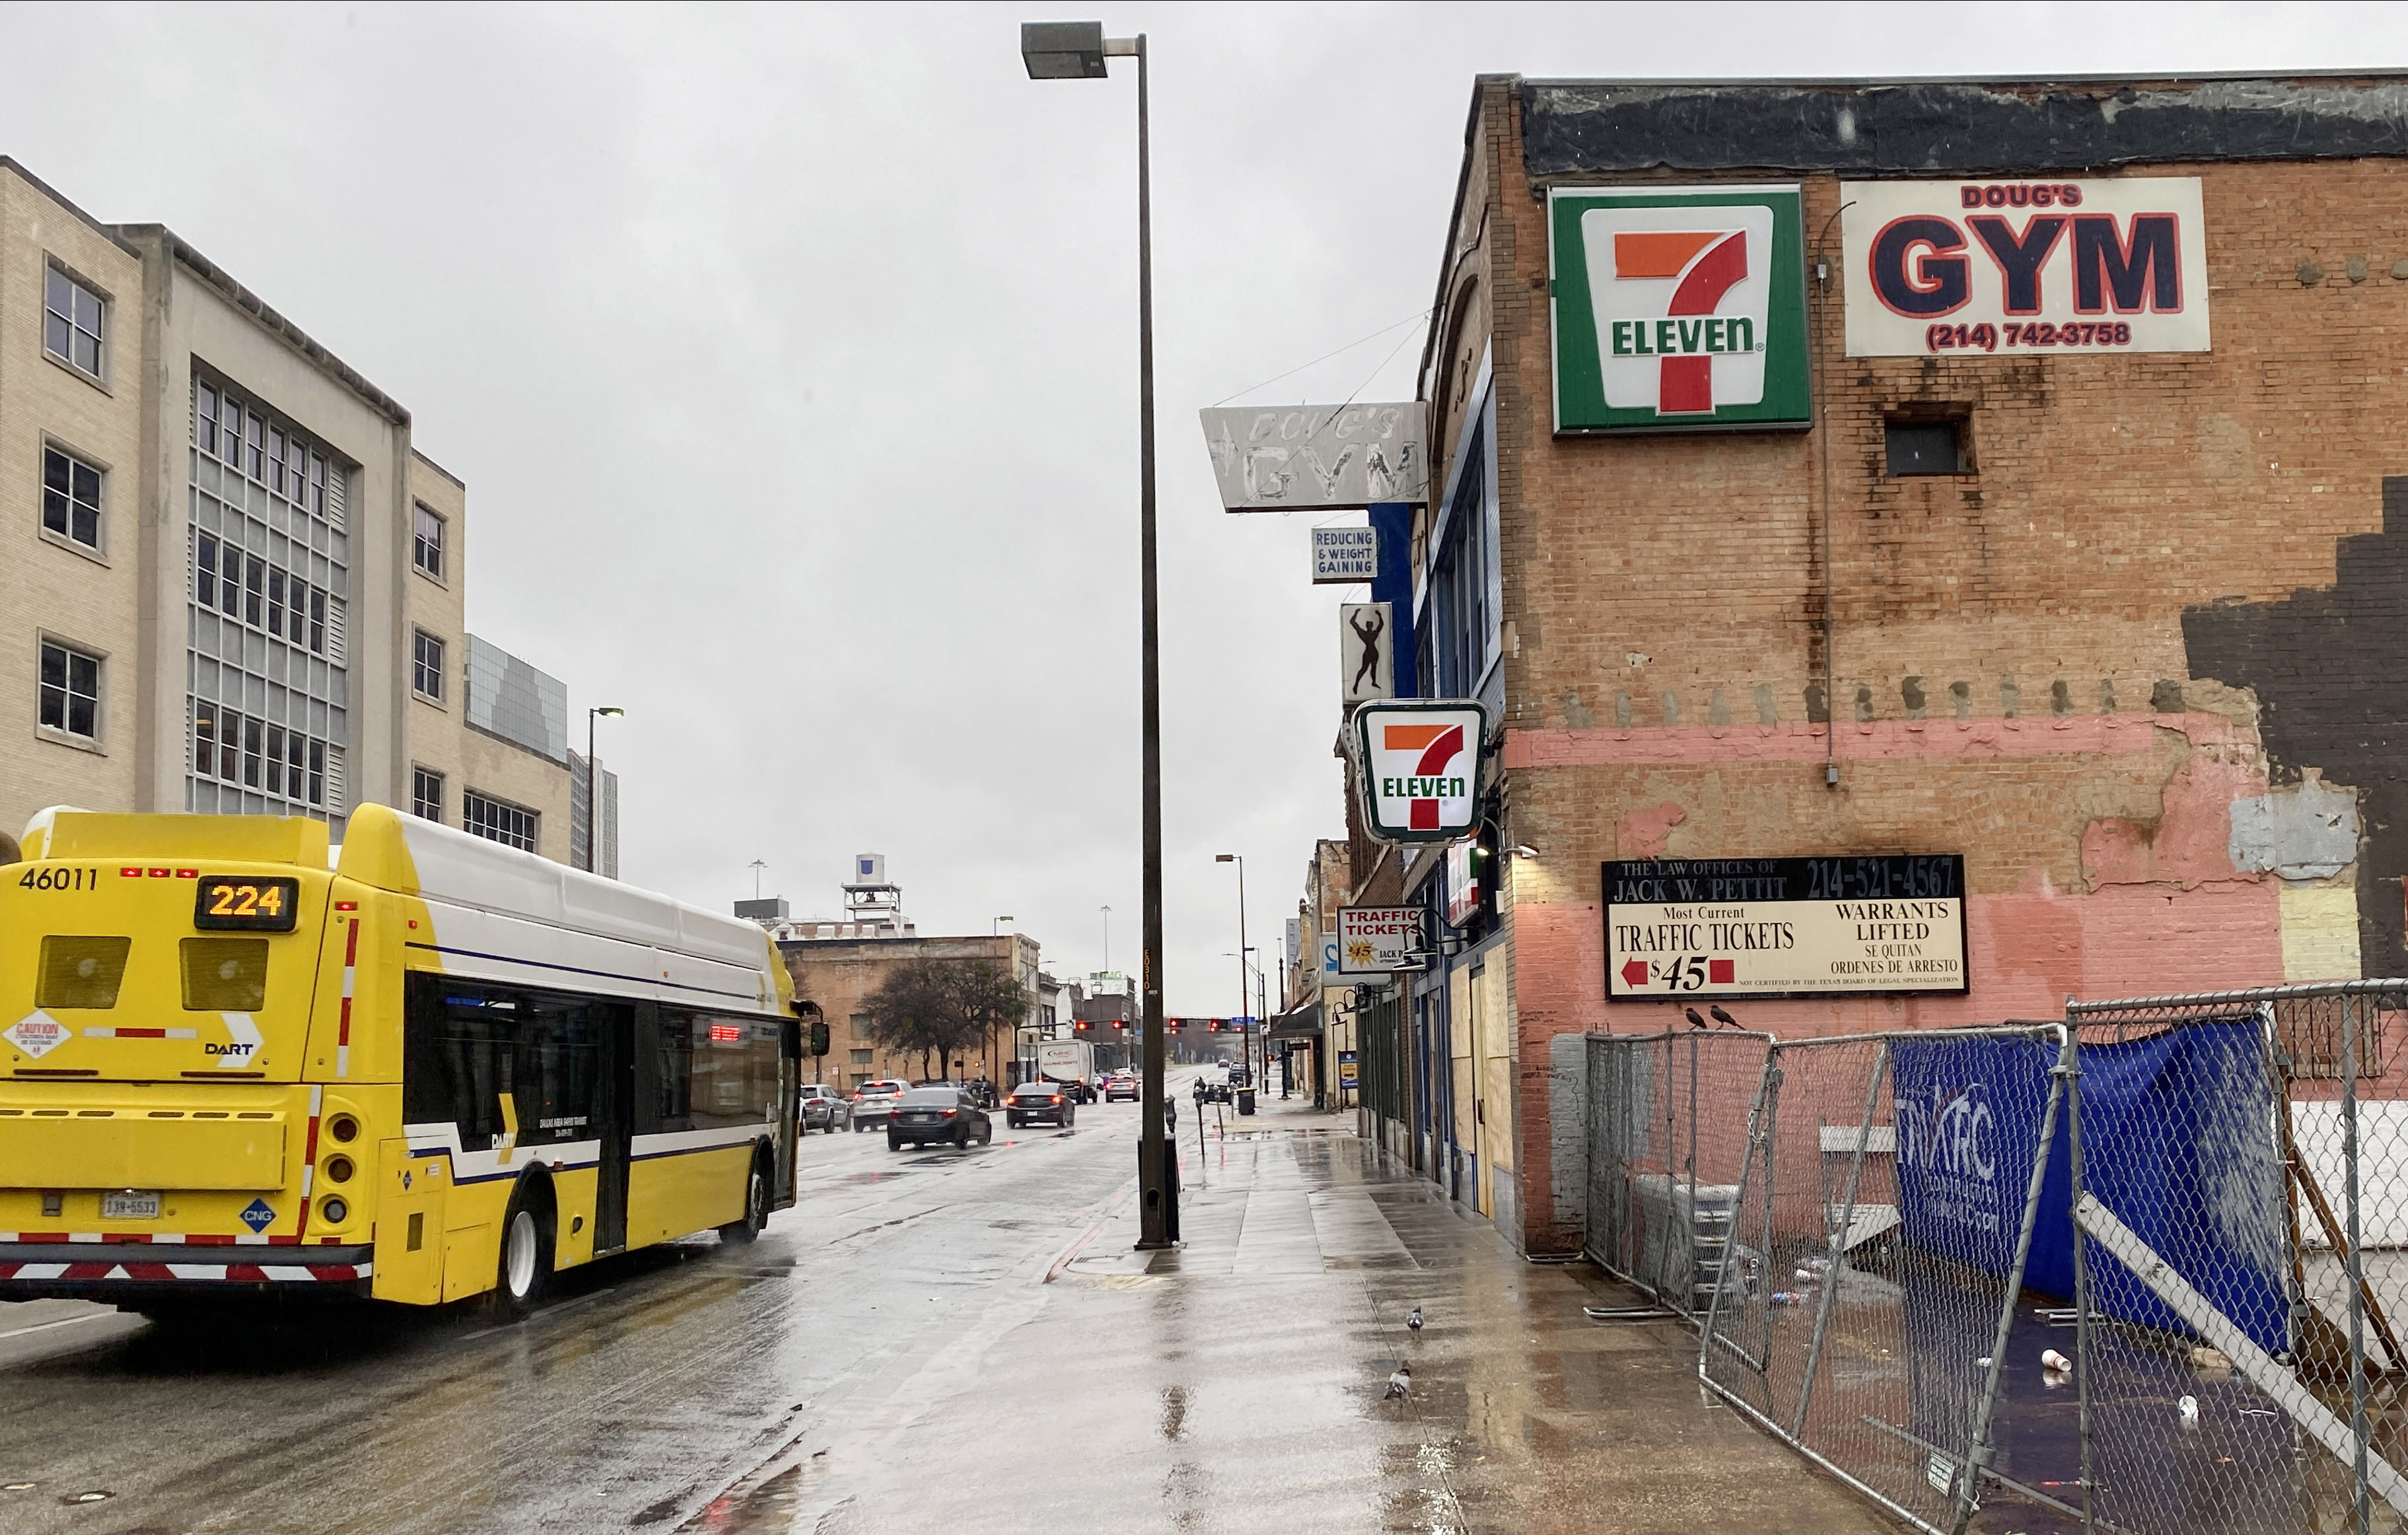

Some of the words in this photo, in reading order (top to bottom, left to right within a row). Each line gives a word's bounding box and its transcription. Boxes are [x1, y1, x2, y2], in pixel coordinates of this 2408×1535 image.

[1961, 184, 2082, 208] DOUG'S
[1869, 212, 2183, 318] GYM
[1614, 230, 1748, 412] 7
[1926, 323, 1998, 352] (214)
[2003, 322, 2131, 347] 742-3758
[1242, 442, 1421, 501] GYM
[1316, 532, 1372, 545] REDUCING
[1318, 549, 1326, 559] &
[1328, 548, 1372, 559] WEIGHT
[1318, 561, 1372, 573] GAINING
[1384, 725, 1464, 830] 7
[1622, 863, 1652, 876] THE
[1658, 862, 1687, 875] LAW
[1693, 861, 1753, 875] OFFICES
[1758, 860, 1777, 873] OF
[19, 869, 97, 890] 46011
[1807, 857, 1954, 898] 214-521-4567
[1613, 879, 1668, 902] JACK
[1676, 878, 1703, 901] W.
[1711, 877, 1787, 900] PETTIT
[209, 885, 282, 916] 224
[1346, 910, 1418, 922] TRAFFIC
[1664, 907, 1693, 919] Most
[1698, 906, 1745, 919] Current
[1835, 902, 1949, 919] WARRANTS
[1616, 924, 1703, 952] TRAFFIC
[1709, 922, 1794, 950] TICKETS
[1856, 923, 1930, 941] LIFTED
[1379, 950, 1398, 958] JACK
[1864, 945, 1878, 957] SE
[1882, 944, 1922, 959] QUITAN
[1650, 955, 1709, 991] $45
[1831, 960, 1884, 974] ORDENES
[1888, 960, 1903, 973] DE
[1907, 959, 1958, 973] ARRESTO
[17, 1023, 59, 1034] CAUTION
[205, 1043, 254, 1055] DART
[245, 1210, 272, 1221] CNG
